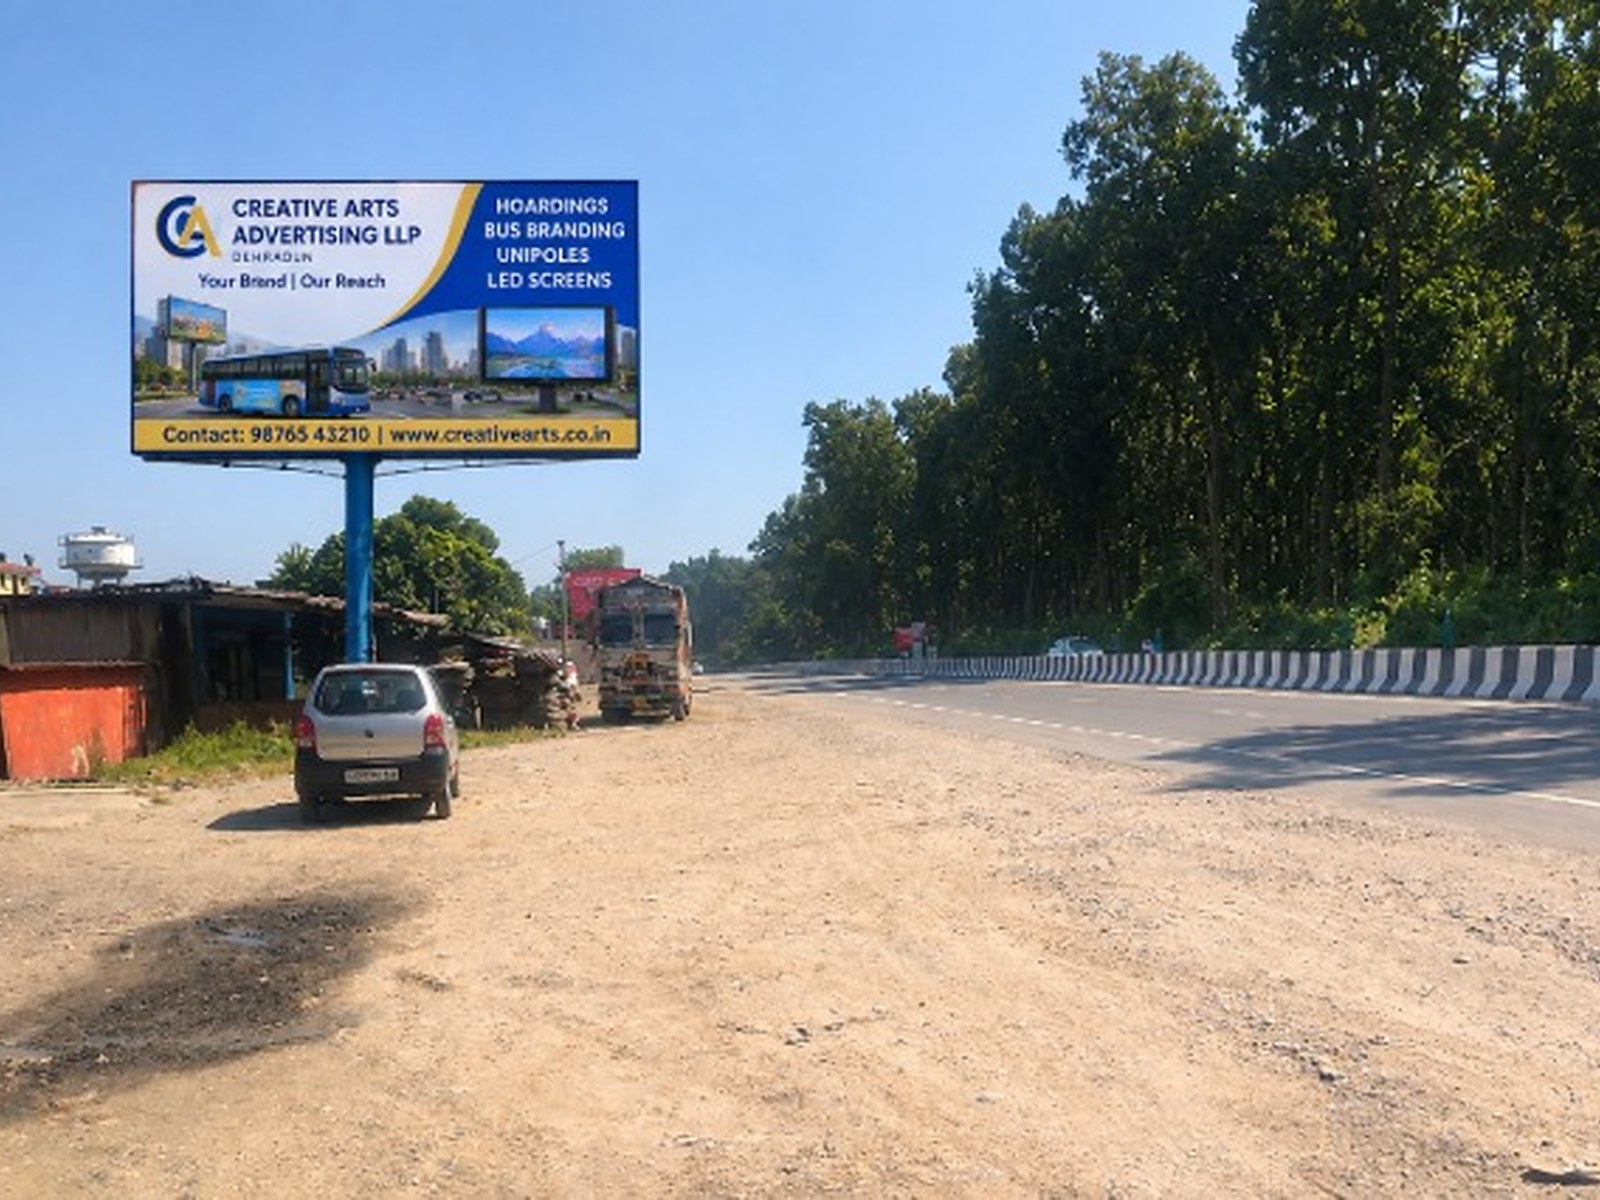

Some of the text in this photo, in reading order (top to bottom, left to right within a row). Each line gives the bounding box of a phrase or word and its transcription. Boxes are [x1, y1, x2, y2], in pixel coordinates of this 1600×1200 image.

[232, 199, 400, 218] CREATIVE ARTS
[496, 198, 609, 215] HOARDINGS
[232, 226, 422, 245] ADVERTISING LLP
[485, 222, 626, 239] BUS BRANDING
[496, 247, 591, 264] UNIPOLES
[199, 273, 235, 289] Your
[240, 273, 287, 289] Brand
[300, 273, 331, 289] Our
[336, 273, 387, 289] Reach
[487, 272, 612, 289] LED SCREENS
[163, 426, 245, 443] Contact:
[250, 426, 309, 443] 98765
[313, 426, 370, 443] 43210
[390, 425, 612, 443] www.creativearts.co.in
